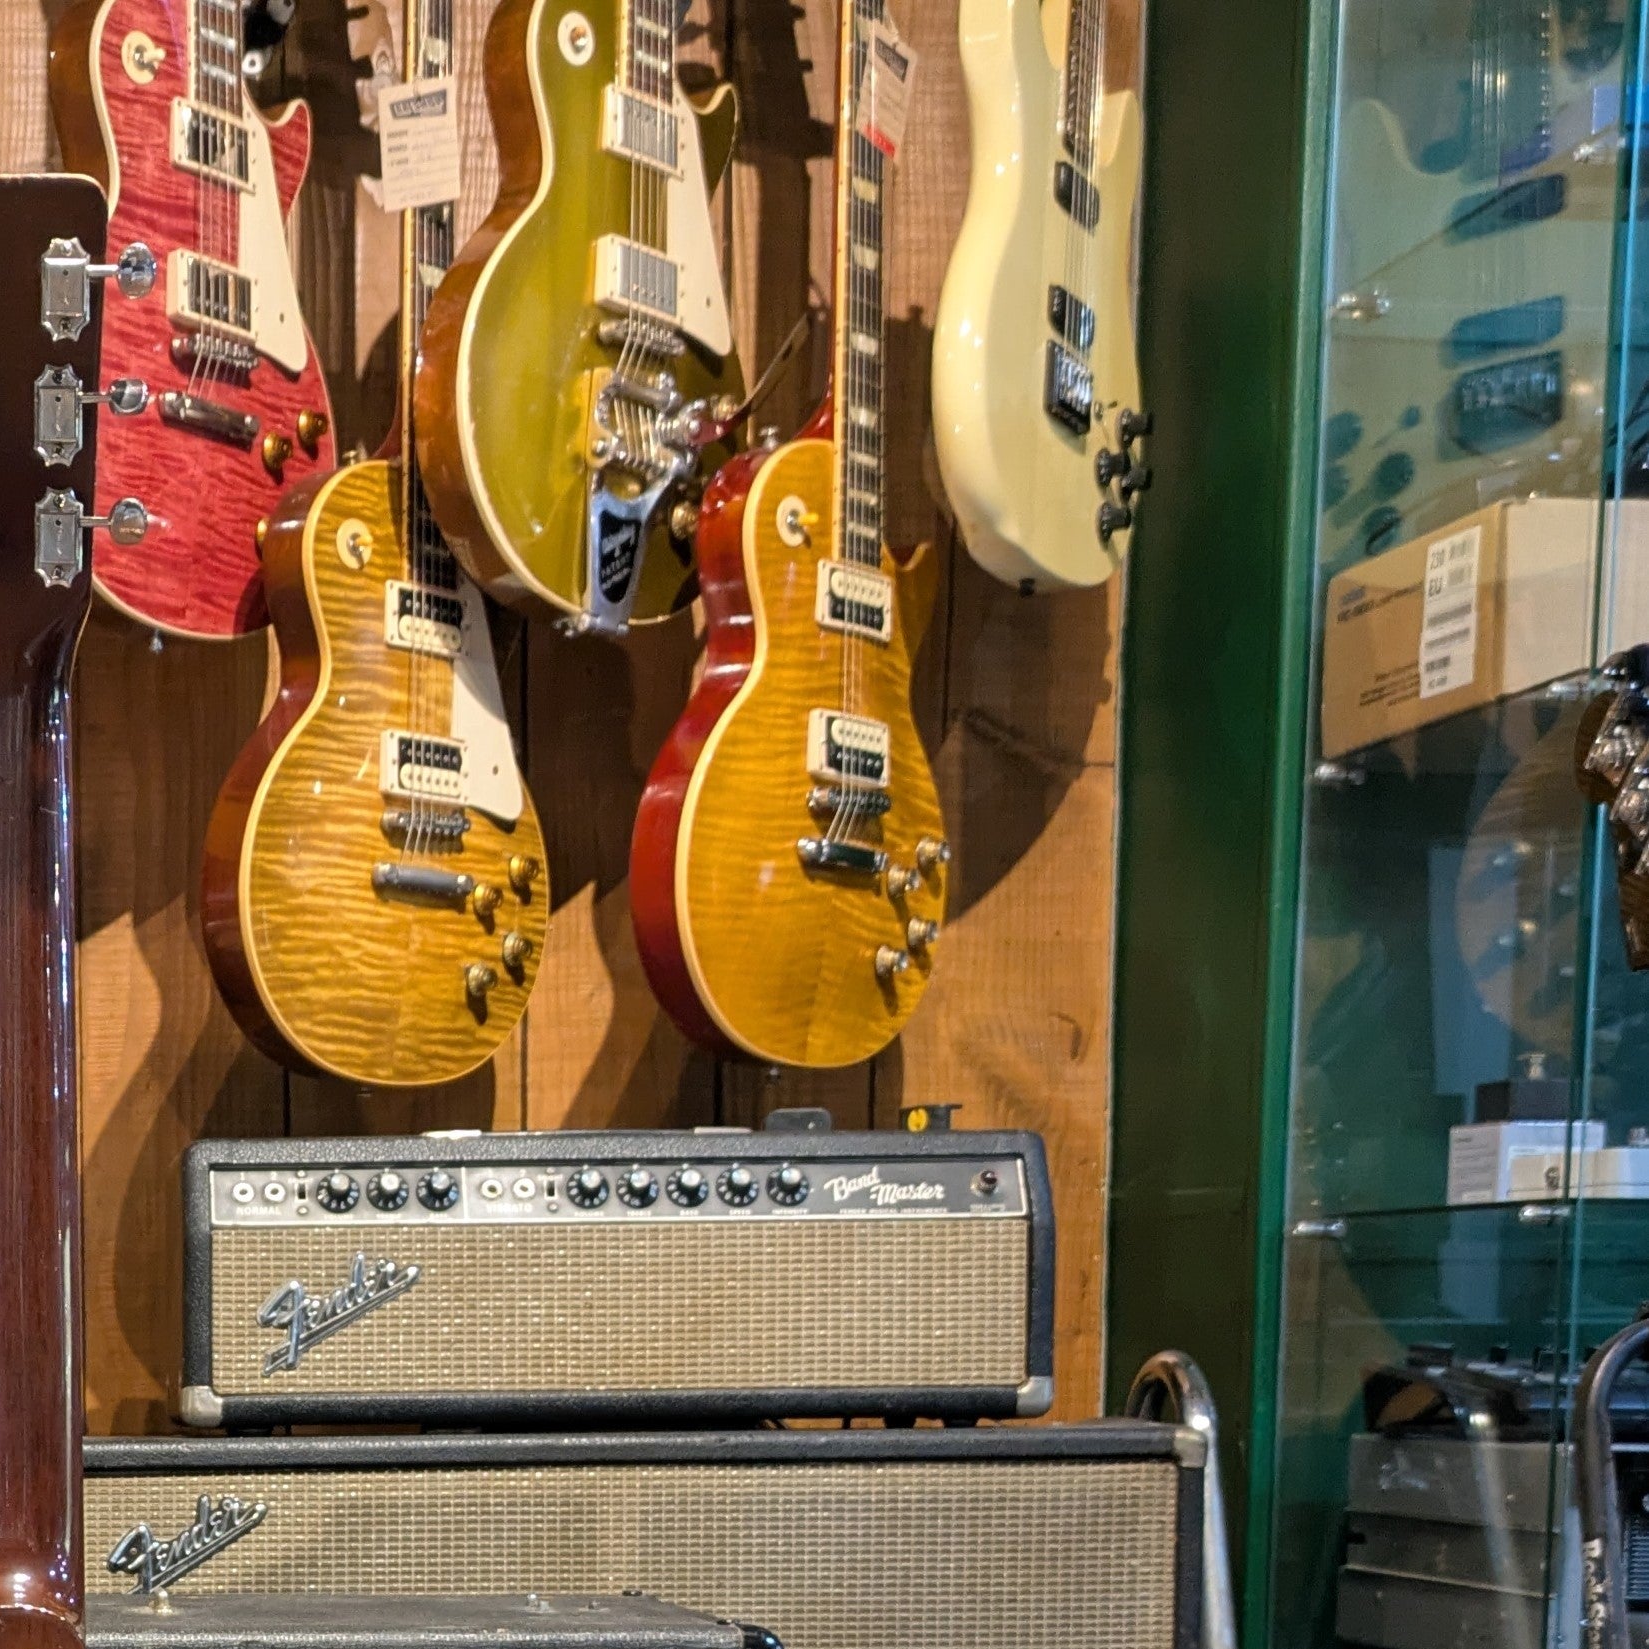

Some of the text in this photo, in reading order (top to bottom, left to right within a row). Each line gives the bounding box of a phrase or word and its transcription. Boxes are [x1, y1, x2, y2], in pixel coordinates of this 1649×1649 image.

[236, 1207, 282, 1216] NORMAL
[824, 1165, 881, 1202] Band
[257, 1251, 420, 1377] Fender
[107, 1494, 268, 1594] Fender
